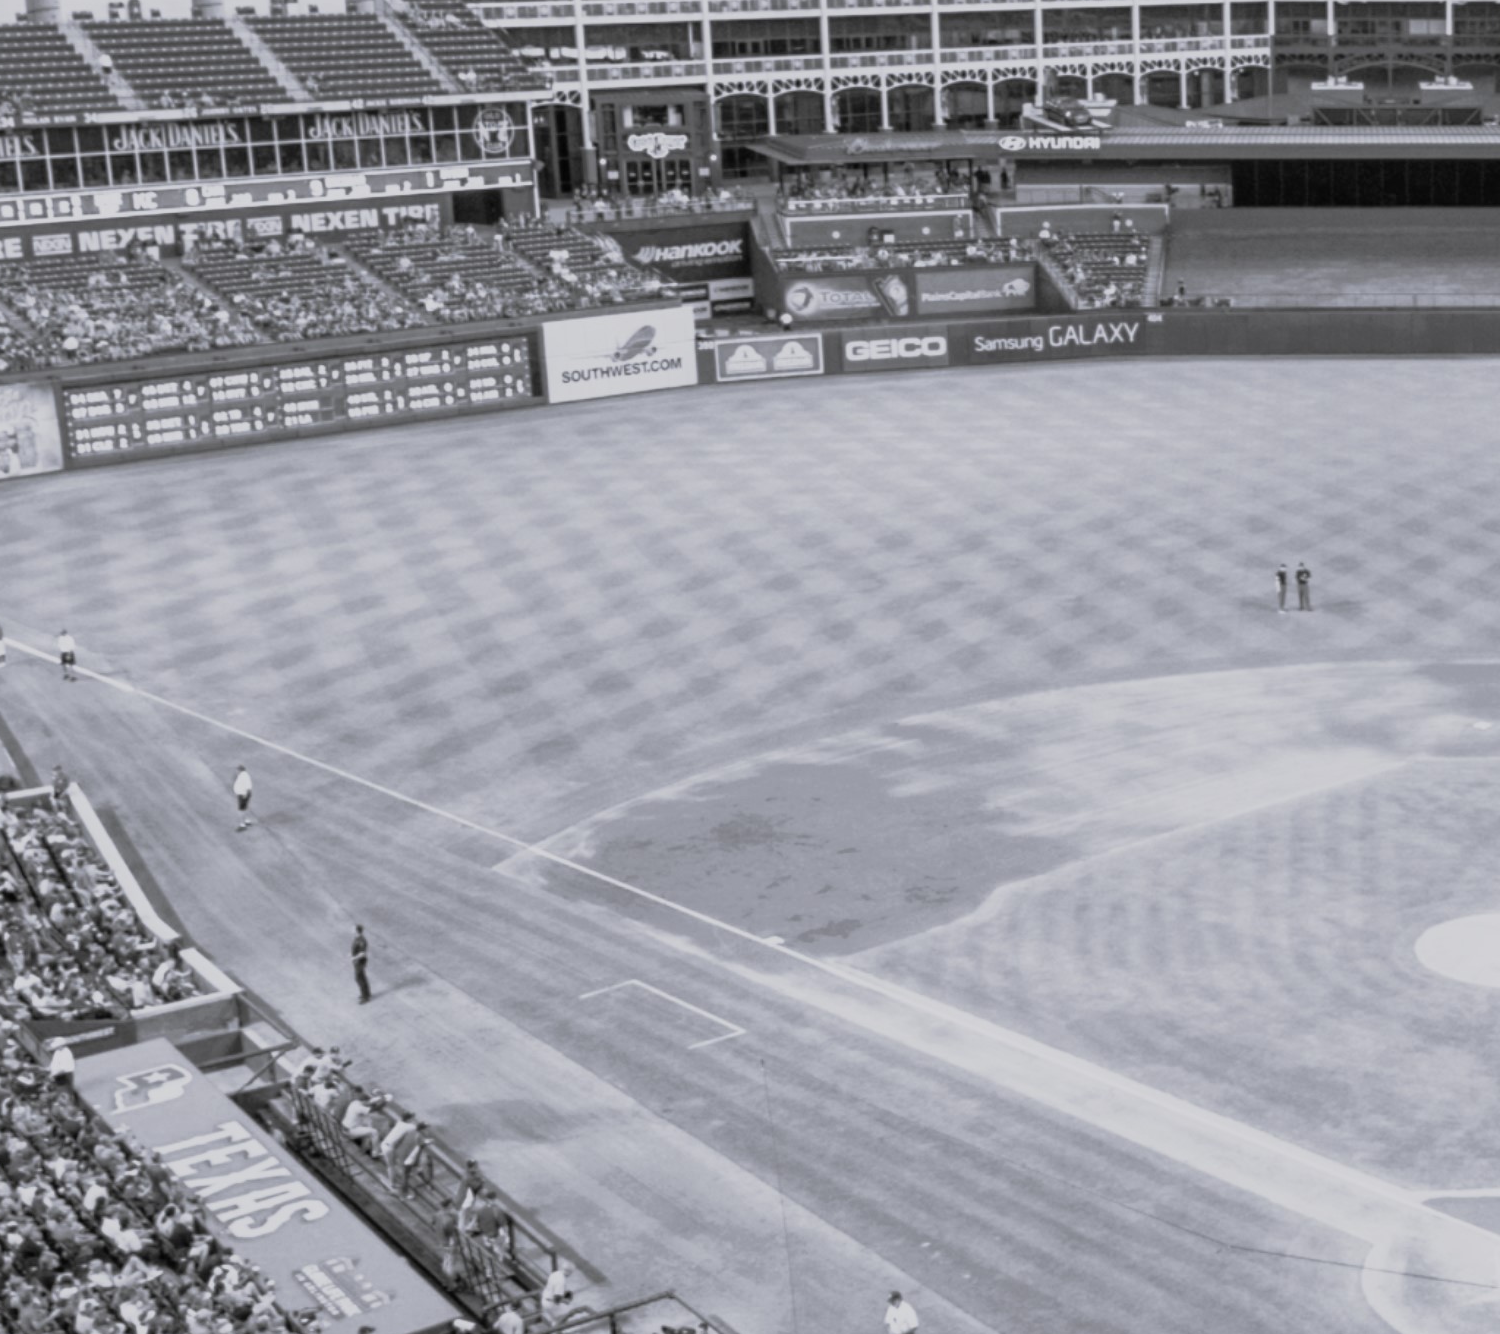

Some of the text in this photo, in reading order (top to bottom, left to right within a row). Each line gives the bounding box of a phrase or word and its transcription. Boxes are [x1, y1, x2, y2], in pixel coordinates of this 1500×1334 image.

[113, 125, 163, 150] JACK
[308, 115, 352, 140] JACK
[1028, 137, 1101, 150] HYUNDAI
[291, 207, 380, 234] NEXEN
[819, 289, 871, 303] TOTAL
[846, 336, 948, 362] GEICO
[974, 322, 1139, 353] Samsung GALAXY
[561, 357, 683, 385] SOUTHWEST.COM
[152, 1119, 330, 1239] TEXAS
